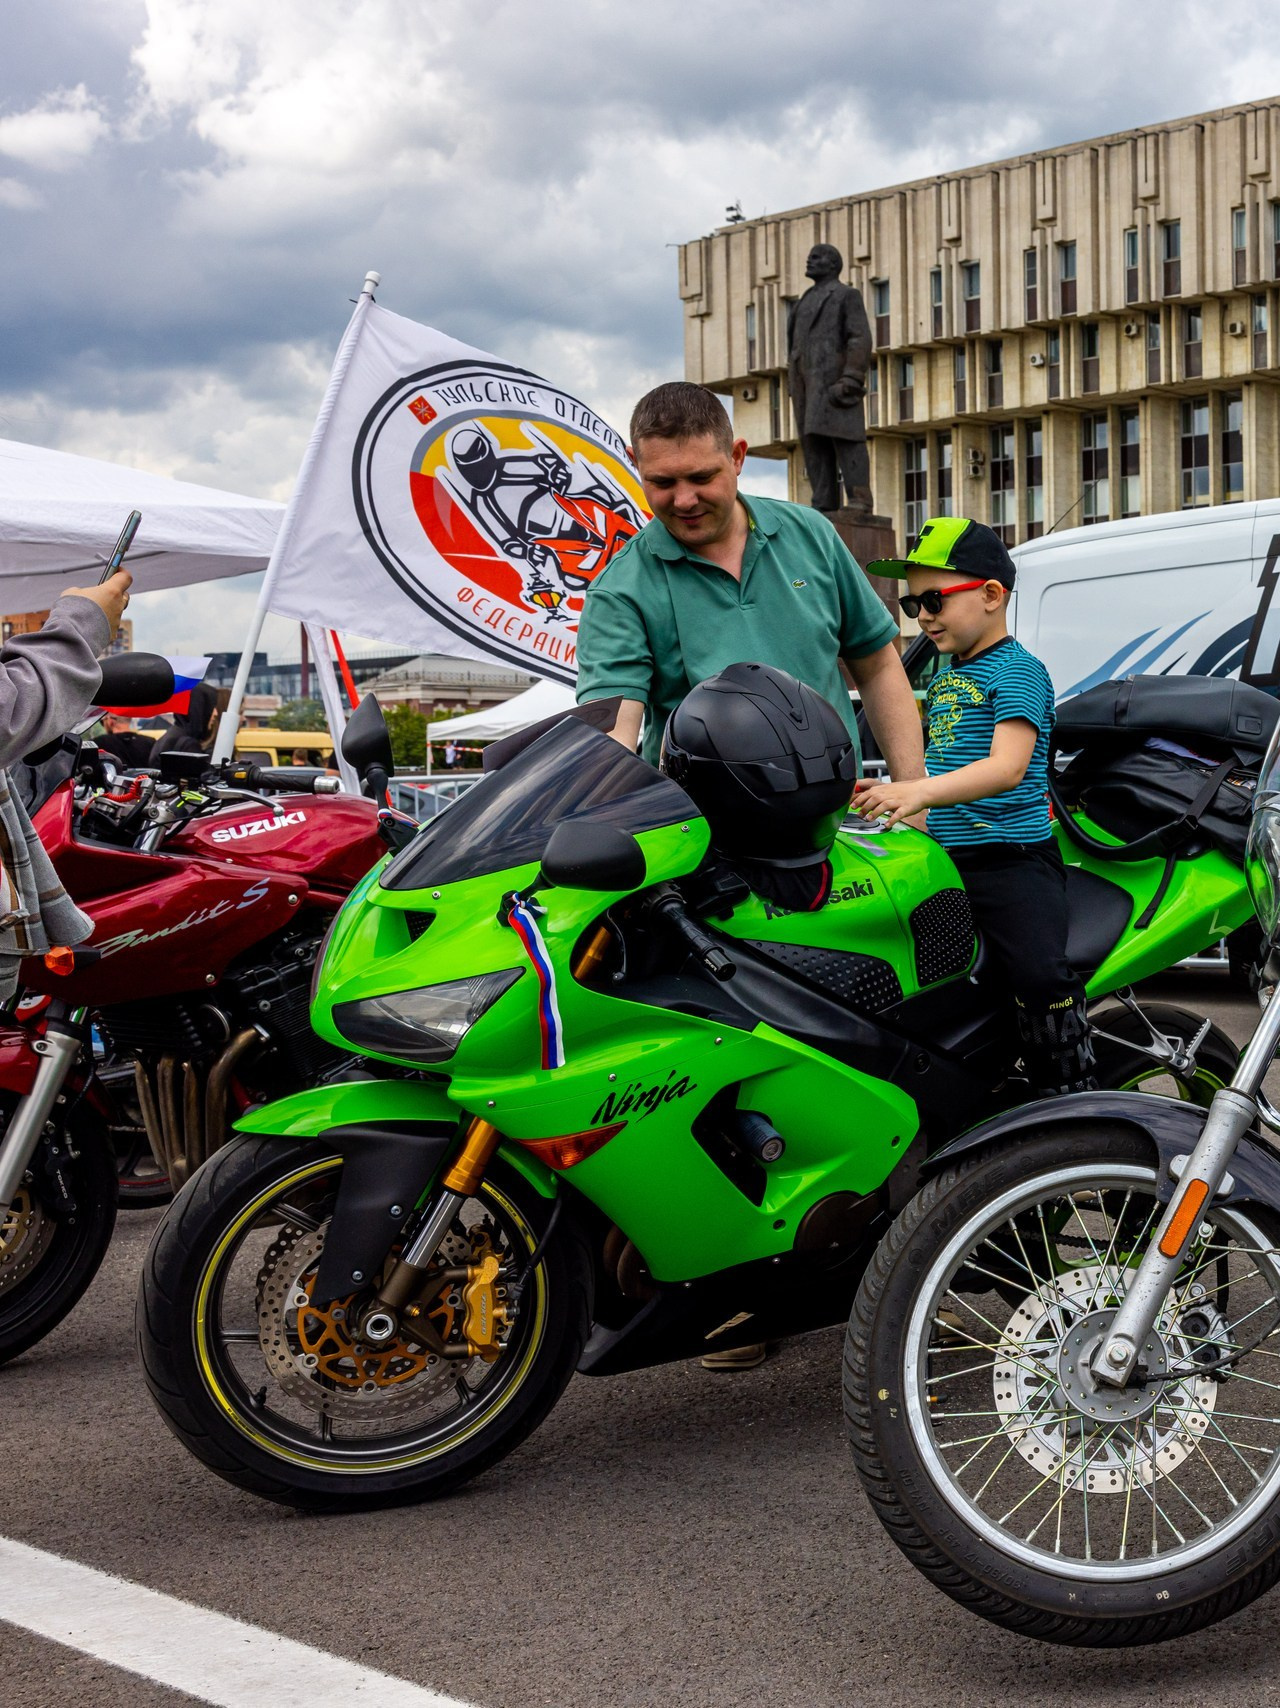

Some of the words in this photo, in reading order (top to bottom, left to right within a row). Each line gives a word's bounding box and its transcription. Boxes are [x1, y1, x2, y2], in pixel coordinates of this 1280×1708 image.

[432, 380, 541, 408] ТУЛЬСКОЕ
[554, 397, 636, 467] ОТДЕЛЕ
[456, 586, 576, 665] ФЕДЕРАЦИ
[211, 811, 307, 844] SUZUKI
[93, 899, 236, 960] Bandit
[236, 876, 271, 910] S
[763, 878, 876, 921] Ksaki
[590, 1069, 698, 1126] Ninja
